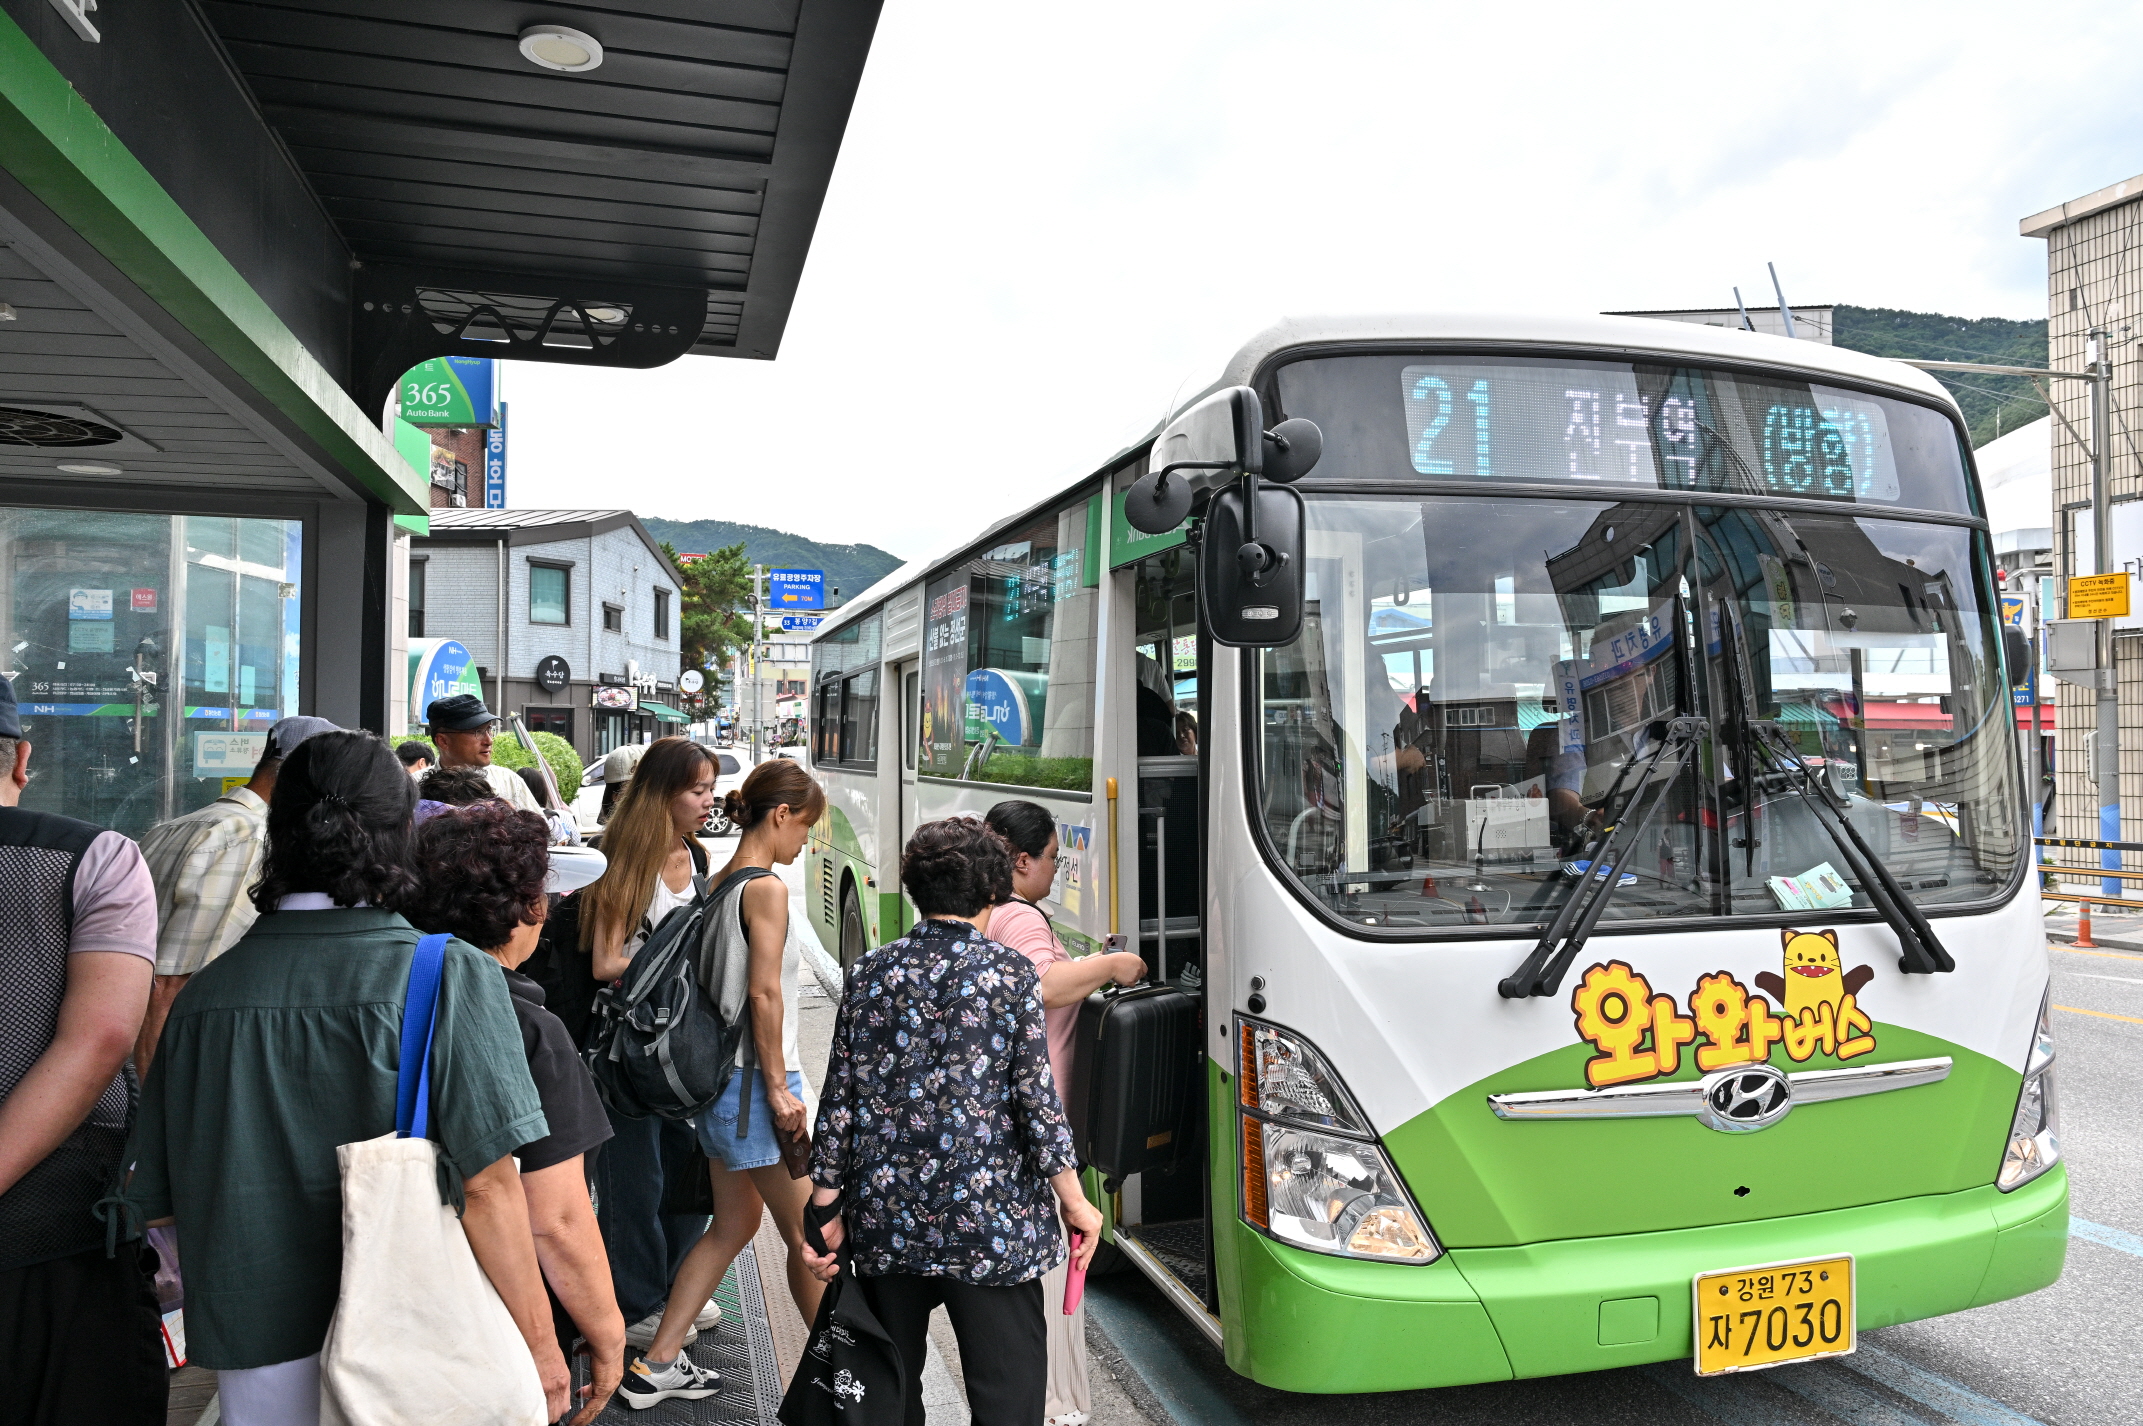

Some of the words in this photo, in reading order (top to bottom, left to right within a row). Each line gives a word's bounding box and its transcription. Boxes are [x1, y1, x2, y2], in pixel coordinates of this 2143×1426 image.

[405, 382, 451, 407] 365
[406, 409, 428, 417] Auto
[428, 409, 450, 418] Bank
[1413, 376, 1490, 476] 21
[1564, 390, 1696, 485] 진부역
[772, 573, 821, 583] 유료공영주차장
[950, 615, 966, 645] 정선군
[448, 646, 457, 655] NH
[1173, 658, 1197, 668] -299
[32, 682, 49, 691] 365
[34, 705, 55, 713] NH
[1572, 960, 1877, 1092] 와와버스
[1737, 1275, 1775, 1302] 강원
[1781, 1270, 1814, 1296] 73
[1706, 1298, 1843, 1357] 자7030
